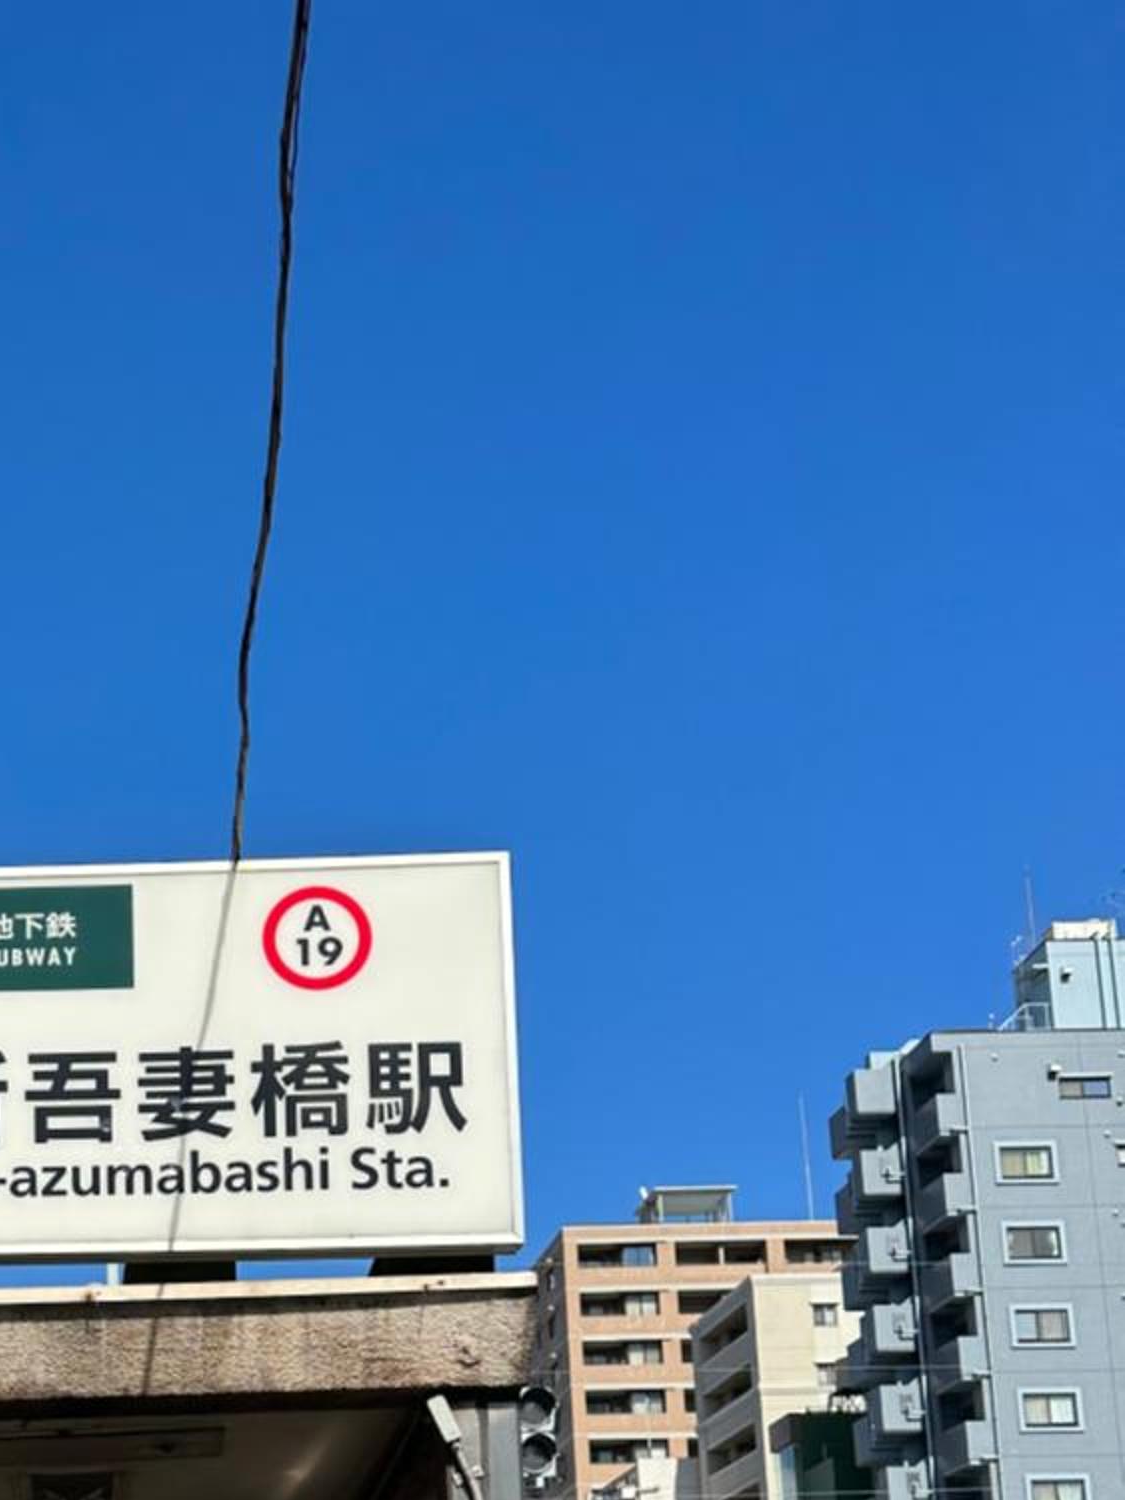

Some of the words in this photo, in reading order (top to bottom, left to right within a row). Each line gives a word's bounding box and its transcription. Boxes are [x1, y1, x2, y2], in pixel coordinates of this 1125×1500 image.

[303, 904, 330, 931] A
[296, 937, 343, 968] 19
[351, 1146, 450, 1190] Sta.
